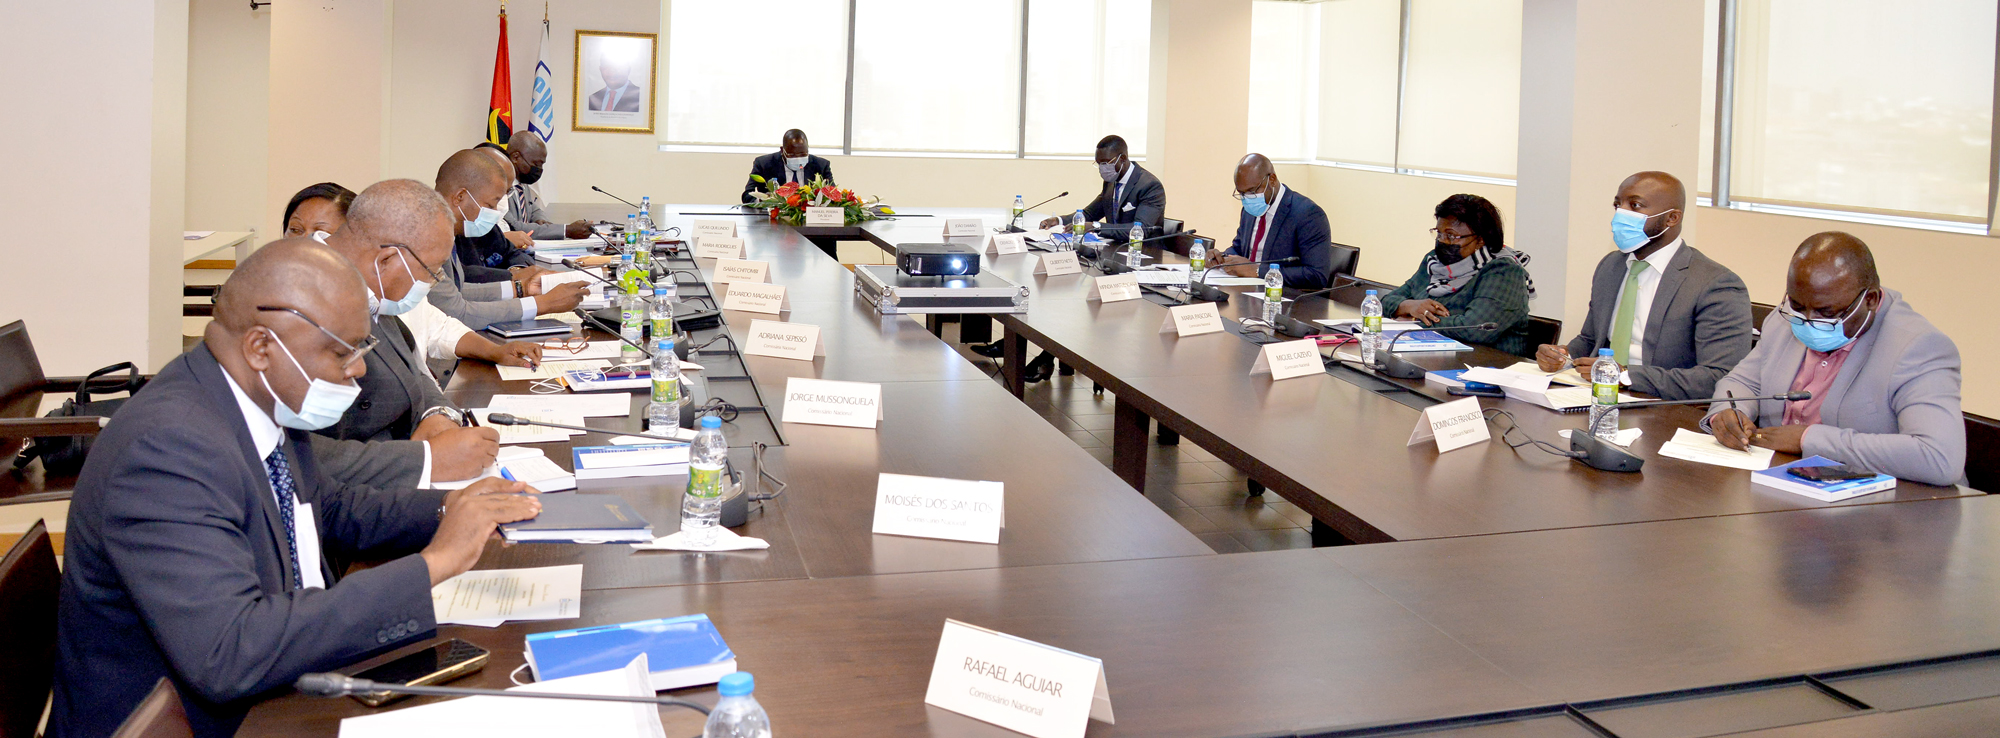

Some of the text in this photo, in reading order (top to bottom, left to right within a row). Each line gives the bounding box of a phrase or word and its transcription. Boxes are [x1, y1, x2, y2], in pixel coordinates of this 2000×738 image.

[728, 290, 752, 298] EDUARDO
[758, 332, 784, 341] ADRIANA
[1275, 353, 1294, 362] MIGUEL
[788, 392, 875, 406] JORGE MUSSONGUELA
[1457, 410, 1482, 424] FRANCISCO
[884, 494, 994, 514] MOISÉS DOS SANTOS
[963, 656, 1063, 699] RAFAEL AGUIAR
[969, 686, 1045, 717] Comissário Nacional
